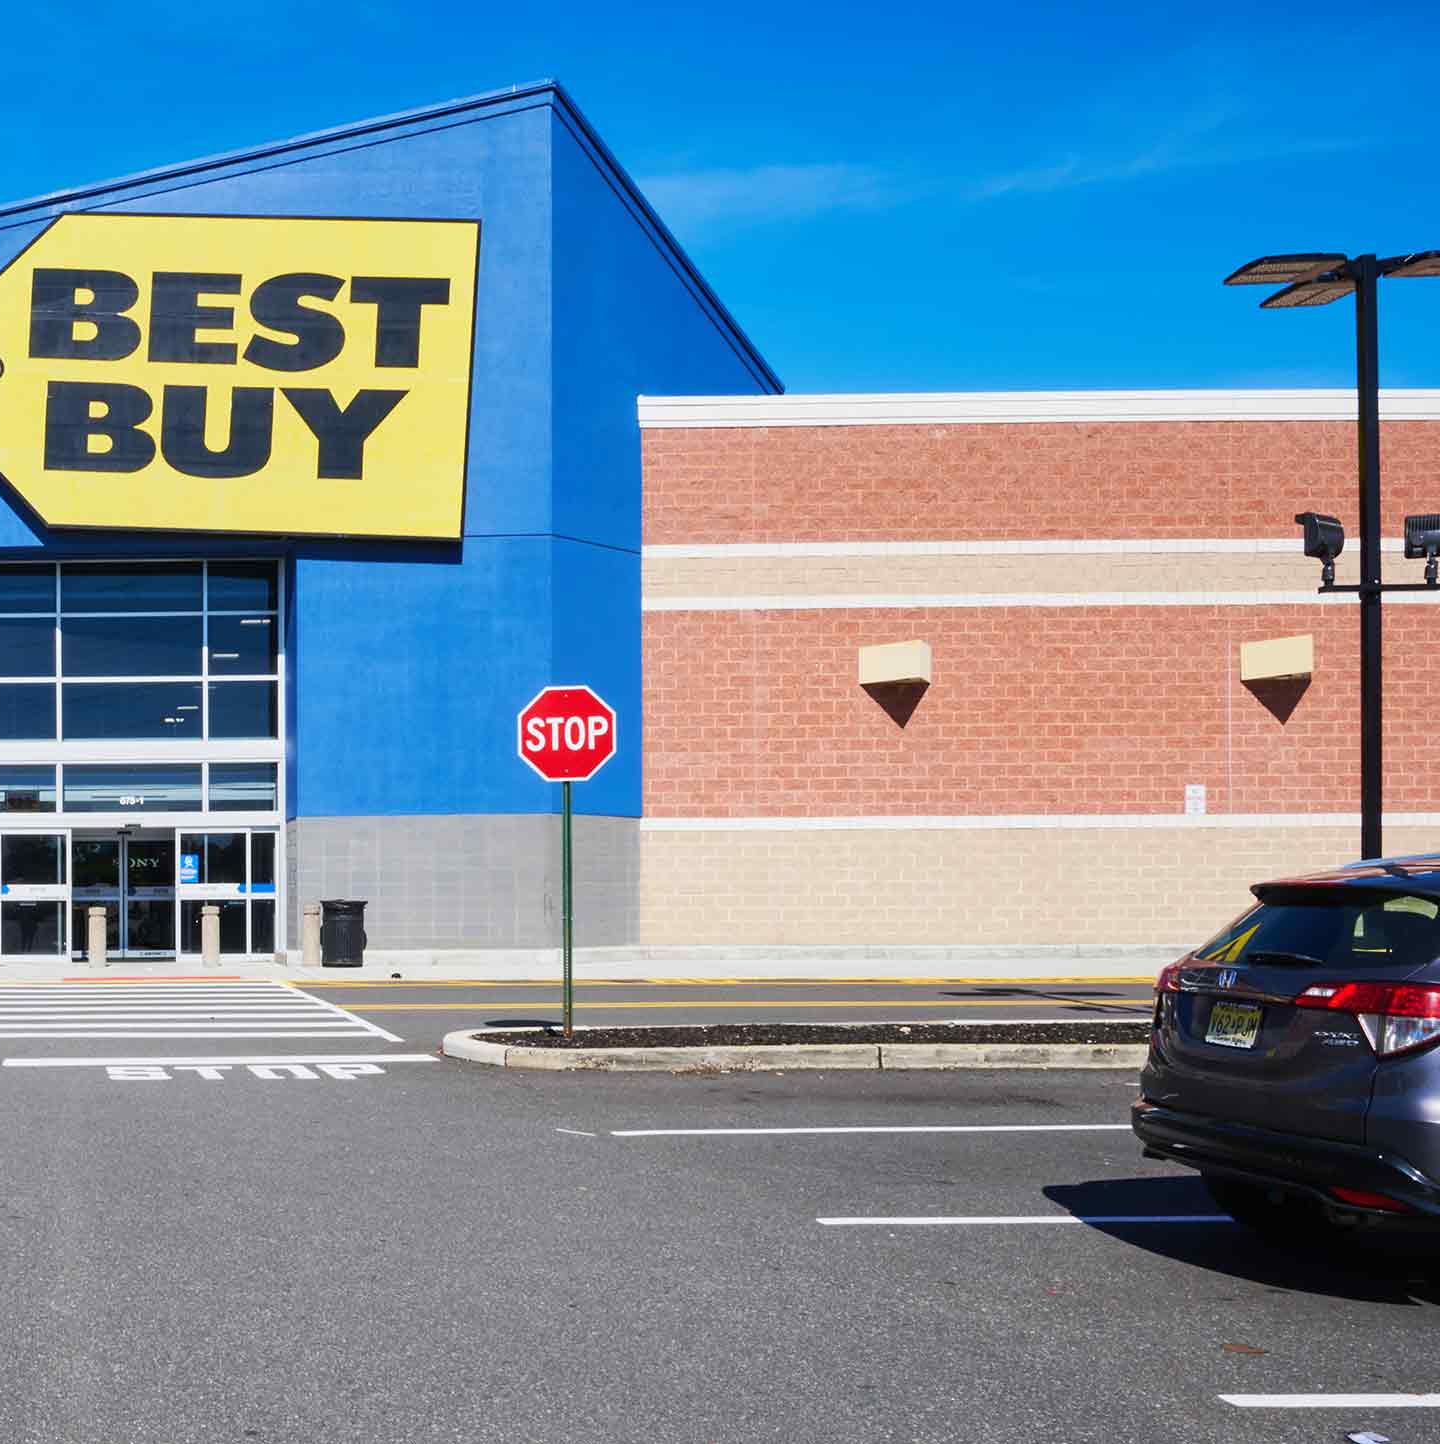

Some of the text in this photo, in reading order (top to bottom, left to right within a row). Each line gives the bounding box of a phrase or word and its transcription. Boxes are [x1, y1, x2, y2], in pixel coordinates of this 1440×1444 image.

[28, 267, 451, 372] BEST
[43, 380, 410, 480] BUY
[526, 716, 609, 752] STOP
[104, 1063, 387, 1081] STOP
